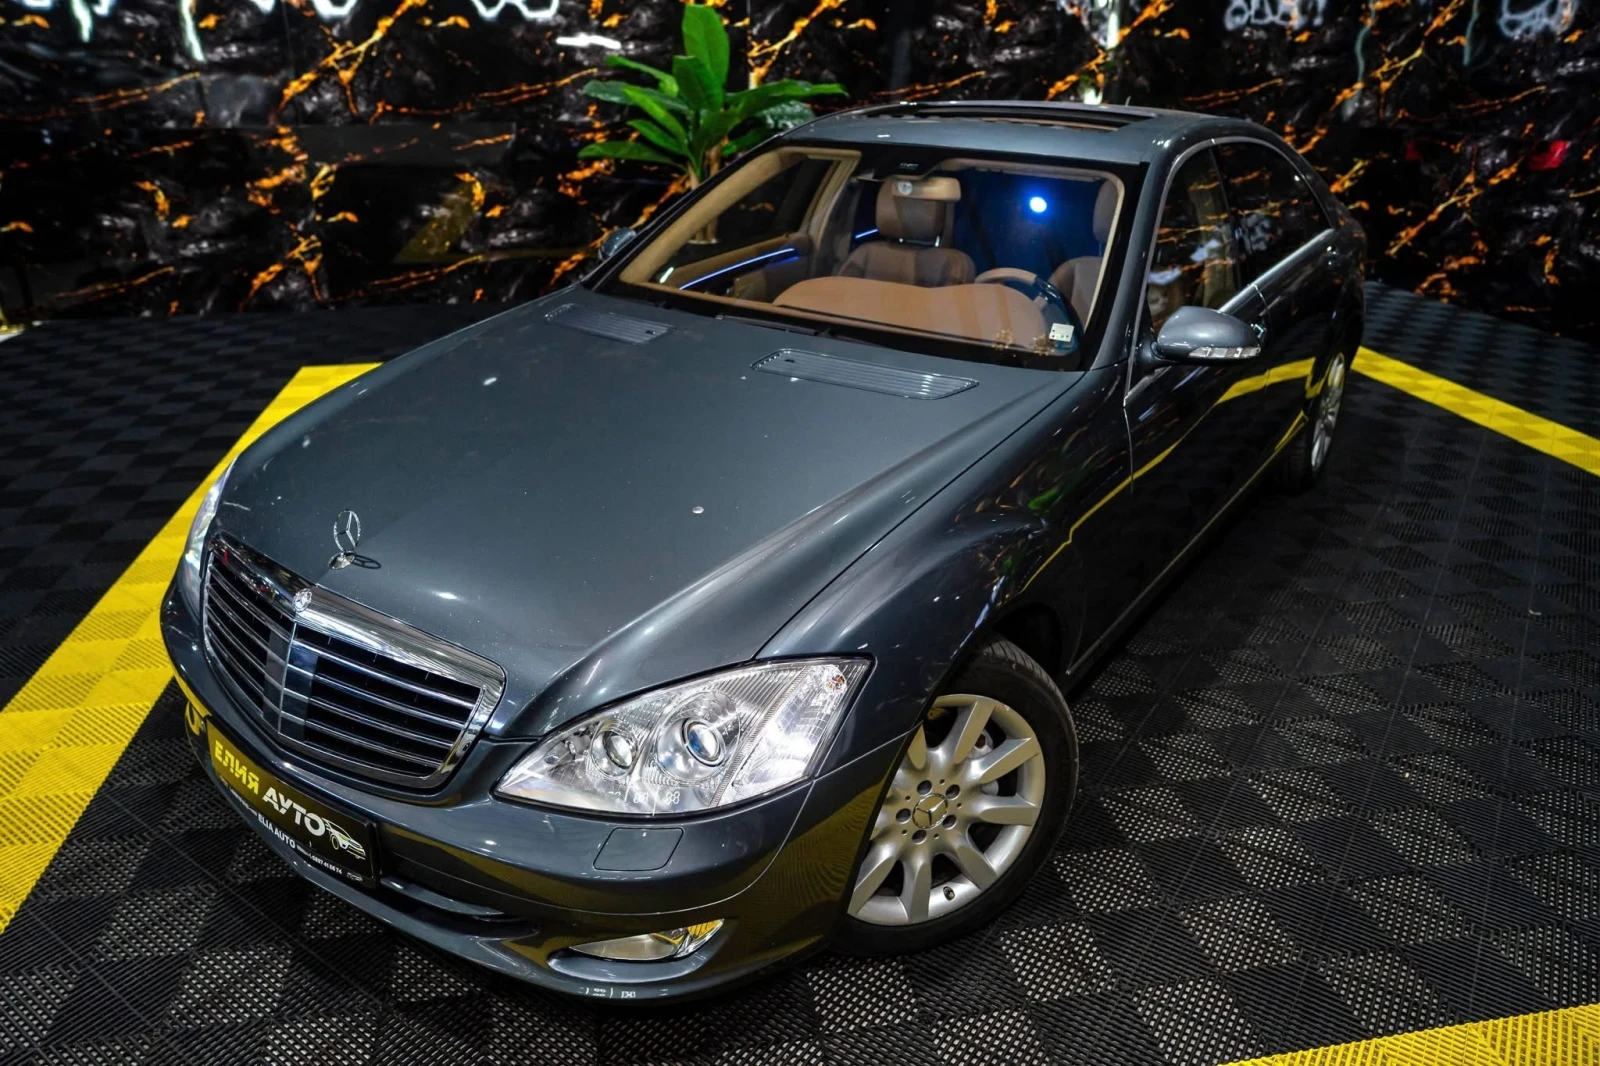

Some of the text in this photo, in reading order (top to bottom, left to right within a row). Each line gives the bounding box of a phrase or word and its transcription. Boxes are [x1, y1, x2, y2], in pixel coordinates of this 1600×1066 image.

[214, 739, 260, 796] ЕЛИЯ
[262, 786, 326, 837] АУТО
[257, 813, 296, 849] ELIA AUTO
